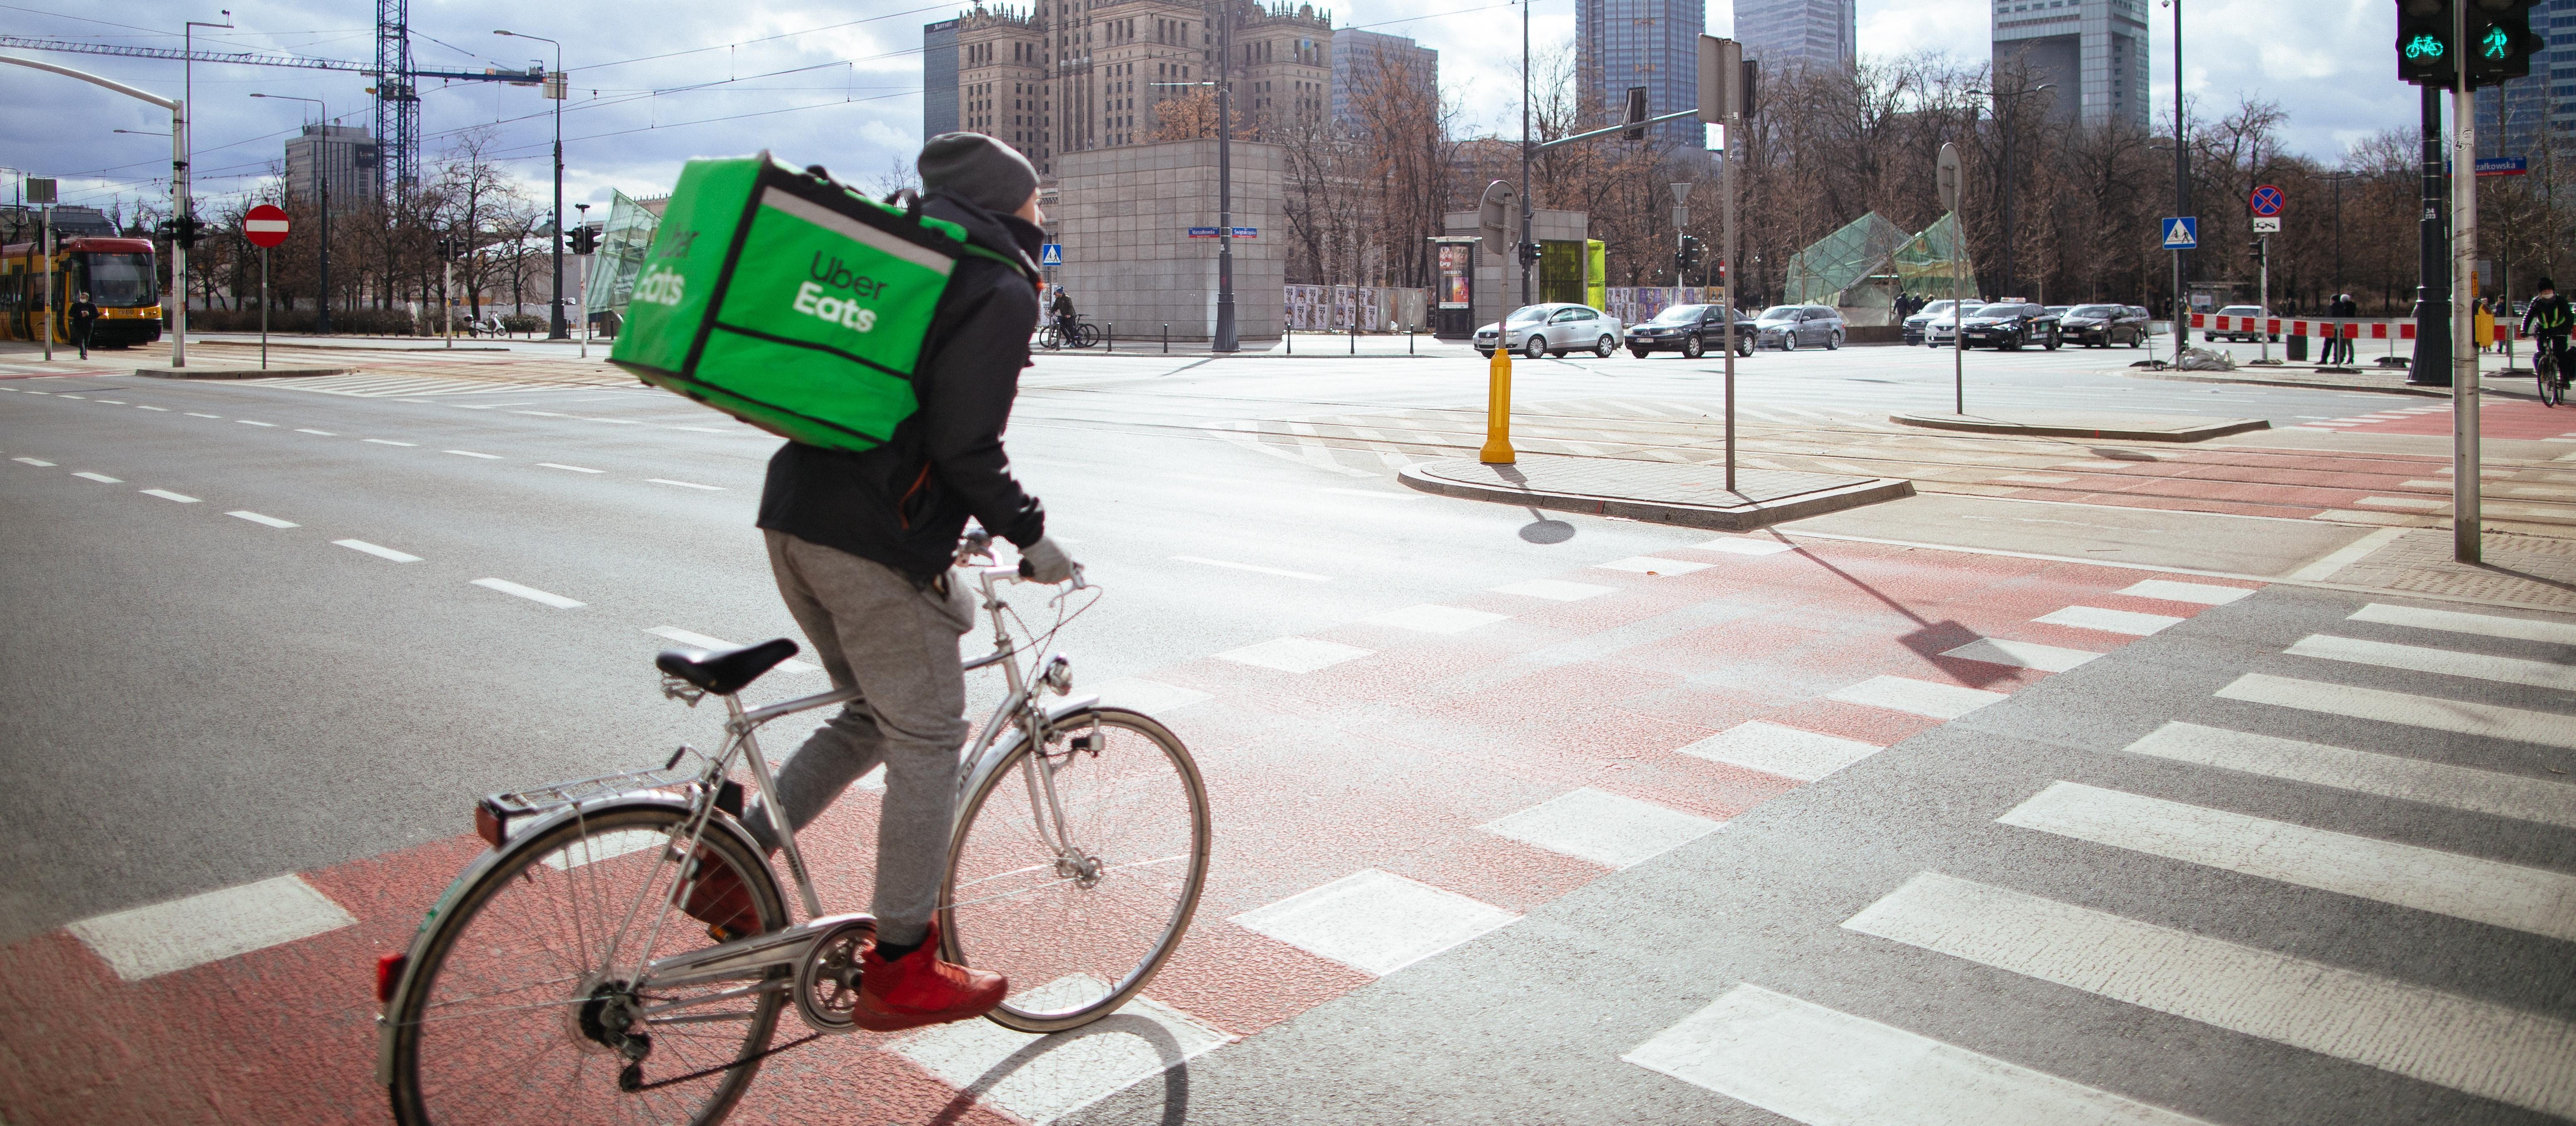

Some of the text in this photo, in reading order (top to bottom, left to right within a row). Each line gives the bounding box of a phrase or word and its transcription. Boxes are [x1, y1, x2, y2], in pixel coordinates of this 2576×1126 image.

[934, 21, 952, 31] Marriott
[811, 250, 888, 301] Uber
[792, 280, 878, 333] Eats
